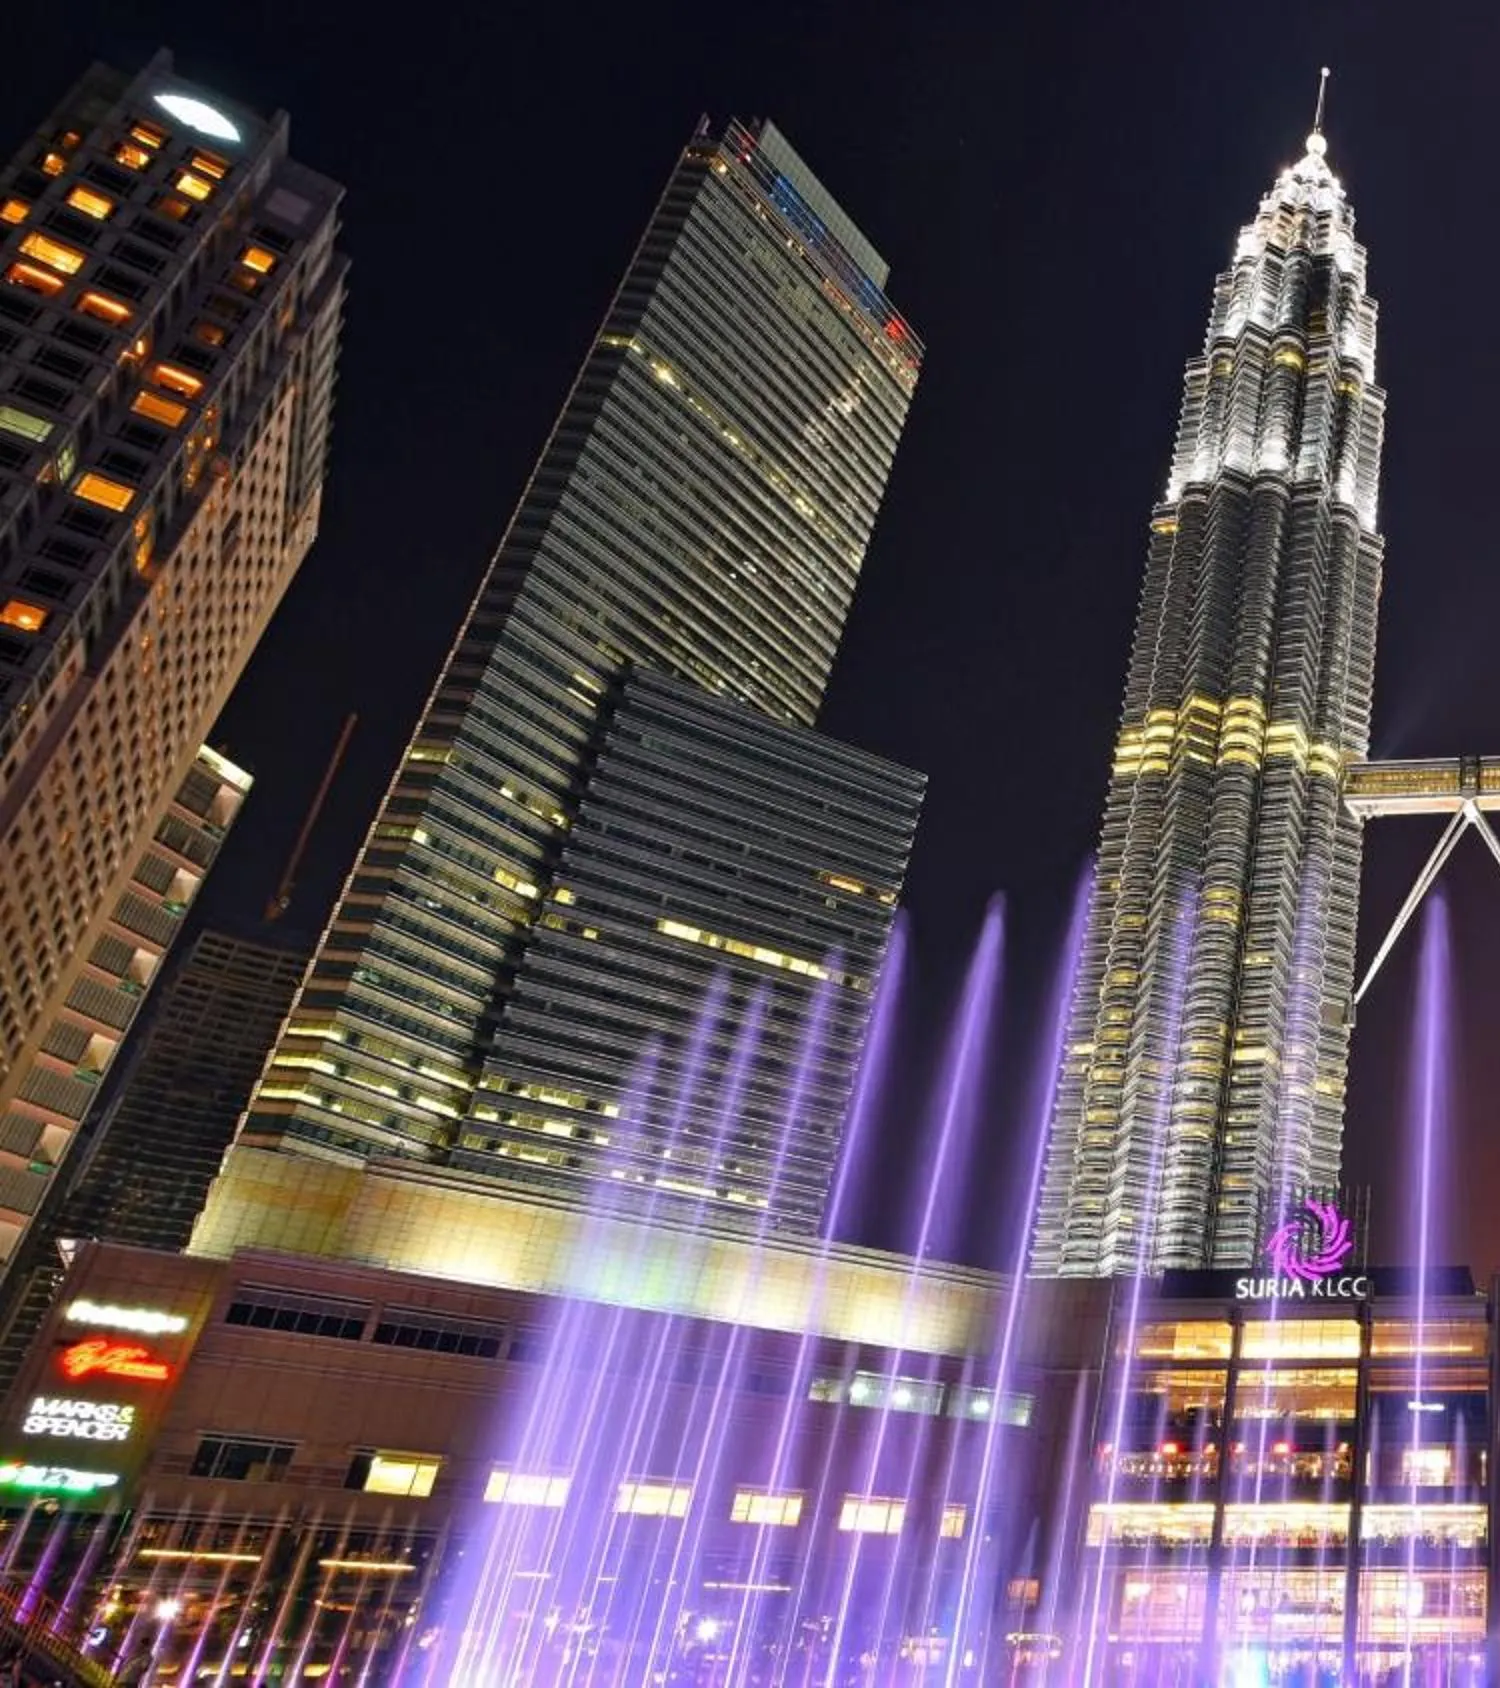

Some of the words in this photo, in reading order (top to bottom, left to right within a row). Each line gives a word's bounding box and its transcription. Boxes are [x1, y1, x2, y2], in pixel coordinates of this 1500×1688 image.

[1235, 1277, 1305, 1299] SURIA
[1311, 1276, 1367, 1297] KLCC
[23, 1416, 131, 1440] SPENCER
